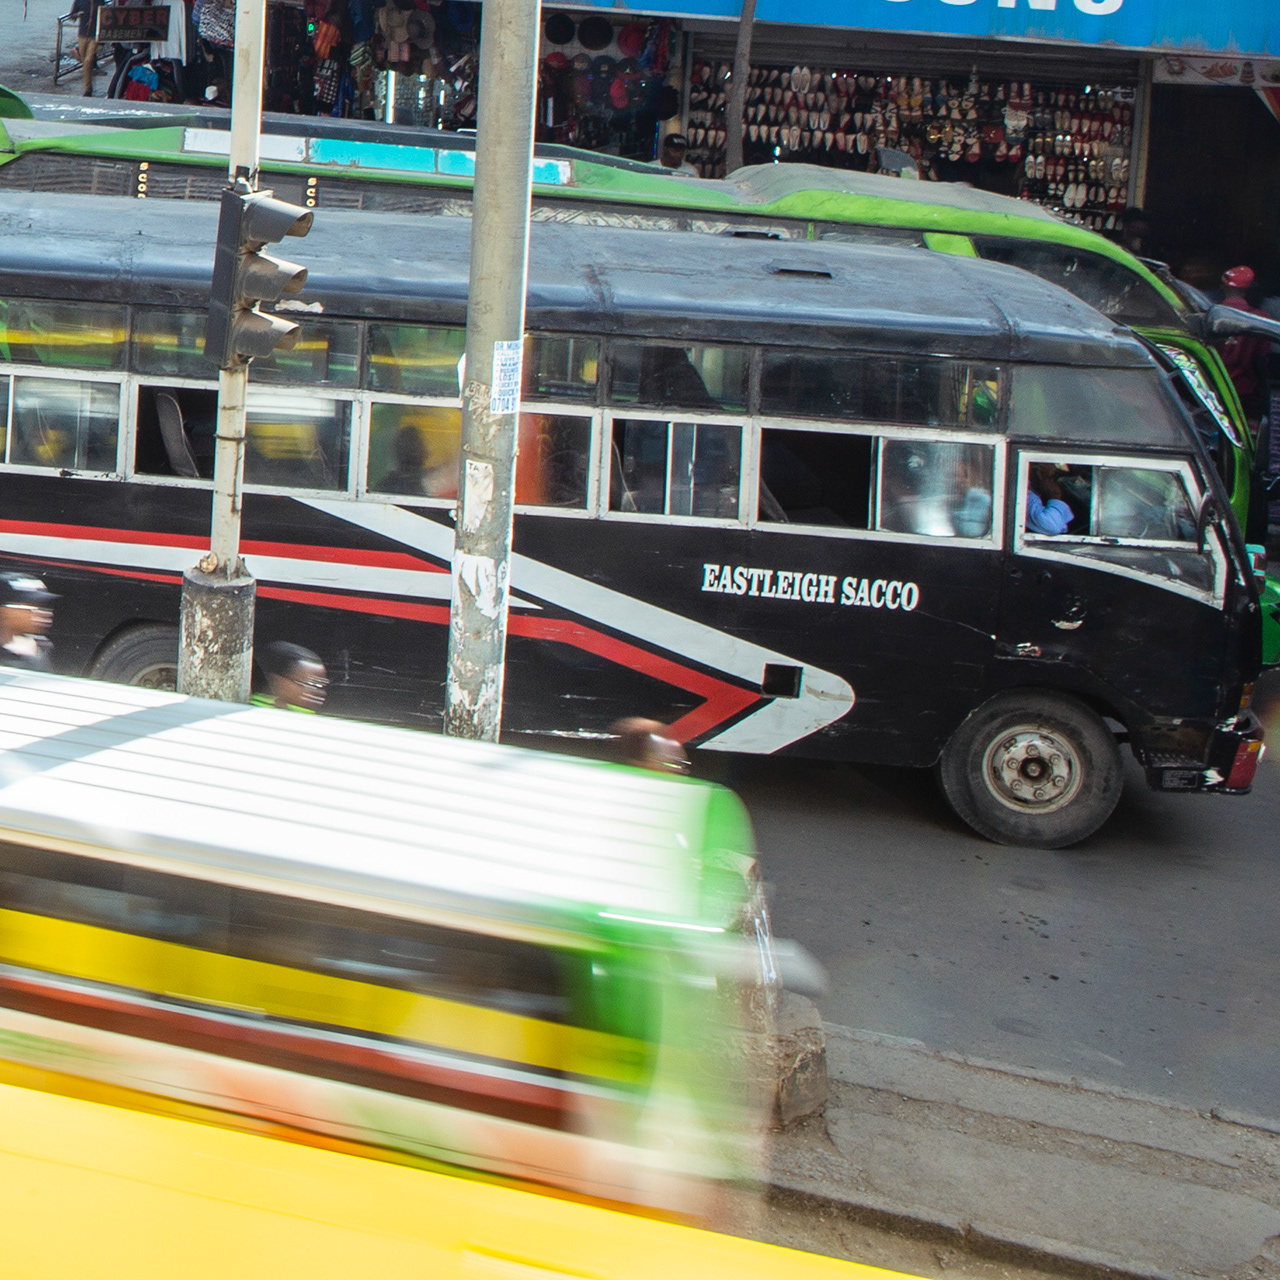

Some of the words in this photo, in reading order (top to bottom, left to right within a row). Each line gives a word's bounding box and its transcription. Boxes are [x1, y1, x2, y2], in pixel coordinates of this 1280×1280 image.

[101, 10, 168, 25] CYBER
[100, 29, 148, 39] BASEMENT
[701, 563, 837, 604] EASTLEIGH
[841, 576, 920, 611] SACCO
